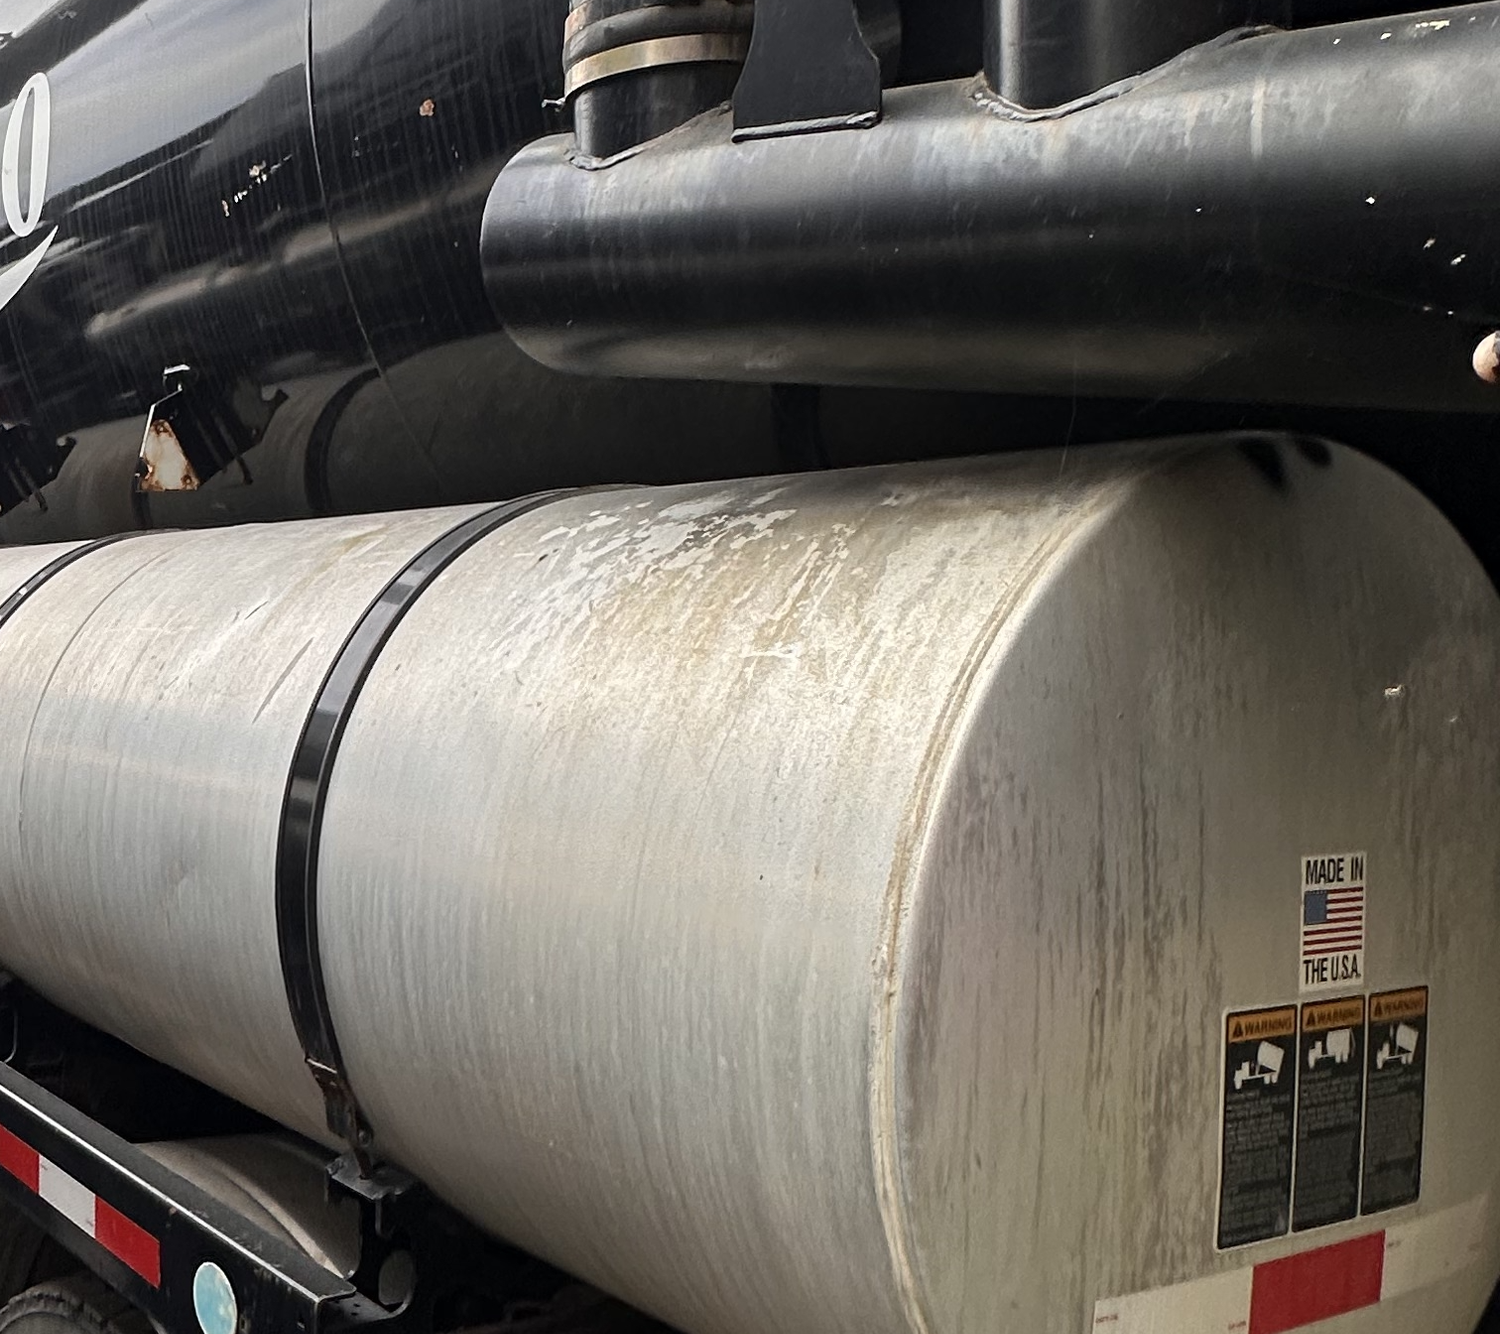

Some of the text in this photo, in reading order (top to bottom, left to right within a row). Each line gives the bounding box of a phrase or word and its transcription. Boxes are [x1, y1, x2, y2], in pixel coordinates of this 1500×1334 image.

[1305, 856, 1363, 884] MADE IN
[1303, 953, 1361, 984] THE U.S.A.
[1383, 998, 1423, 1014] WARNING
[1316, 1007, 1361, 1024] WARNING
[1244, 1020, 1292, 1036] WARNING
